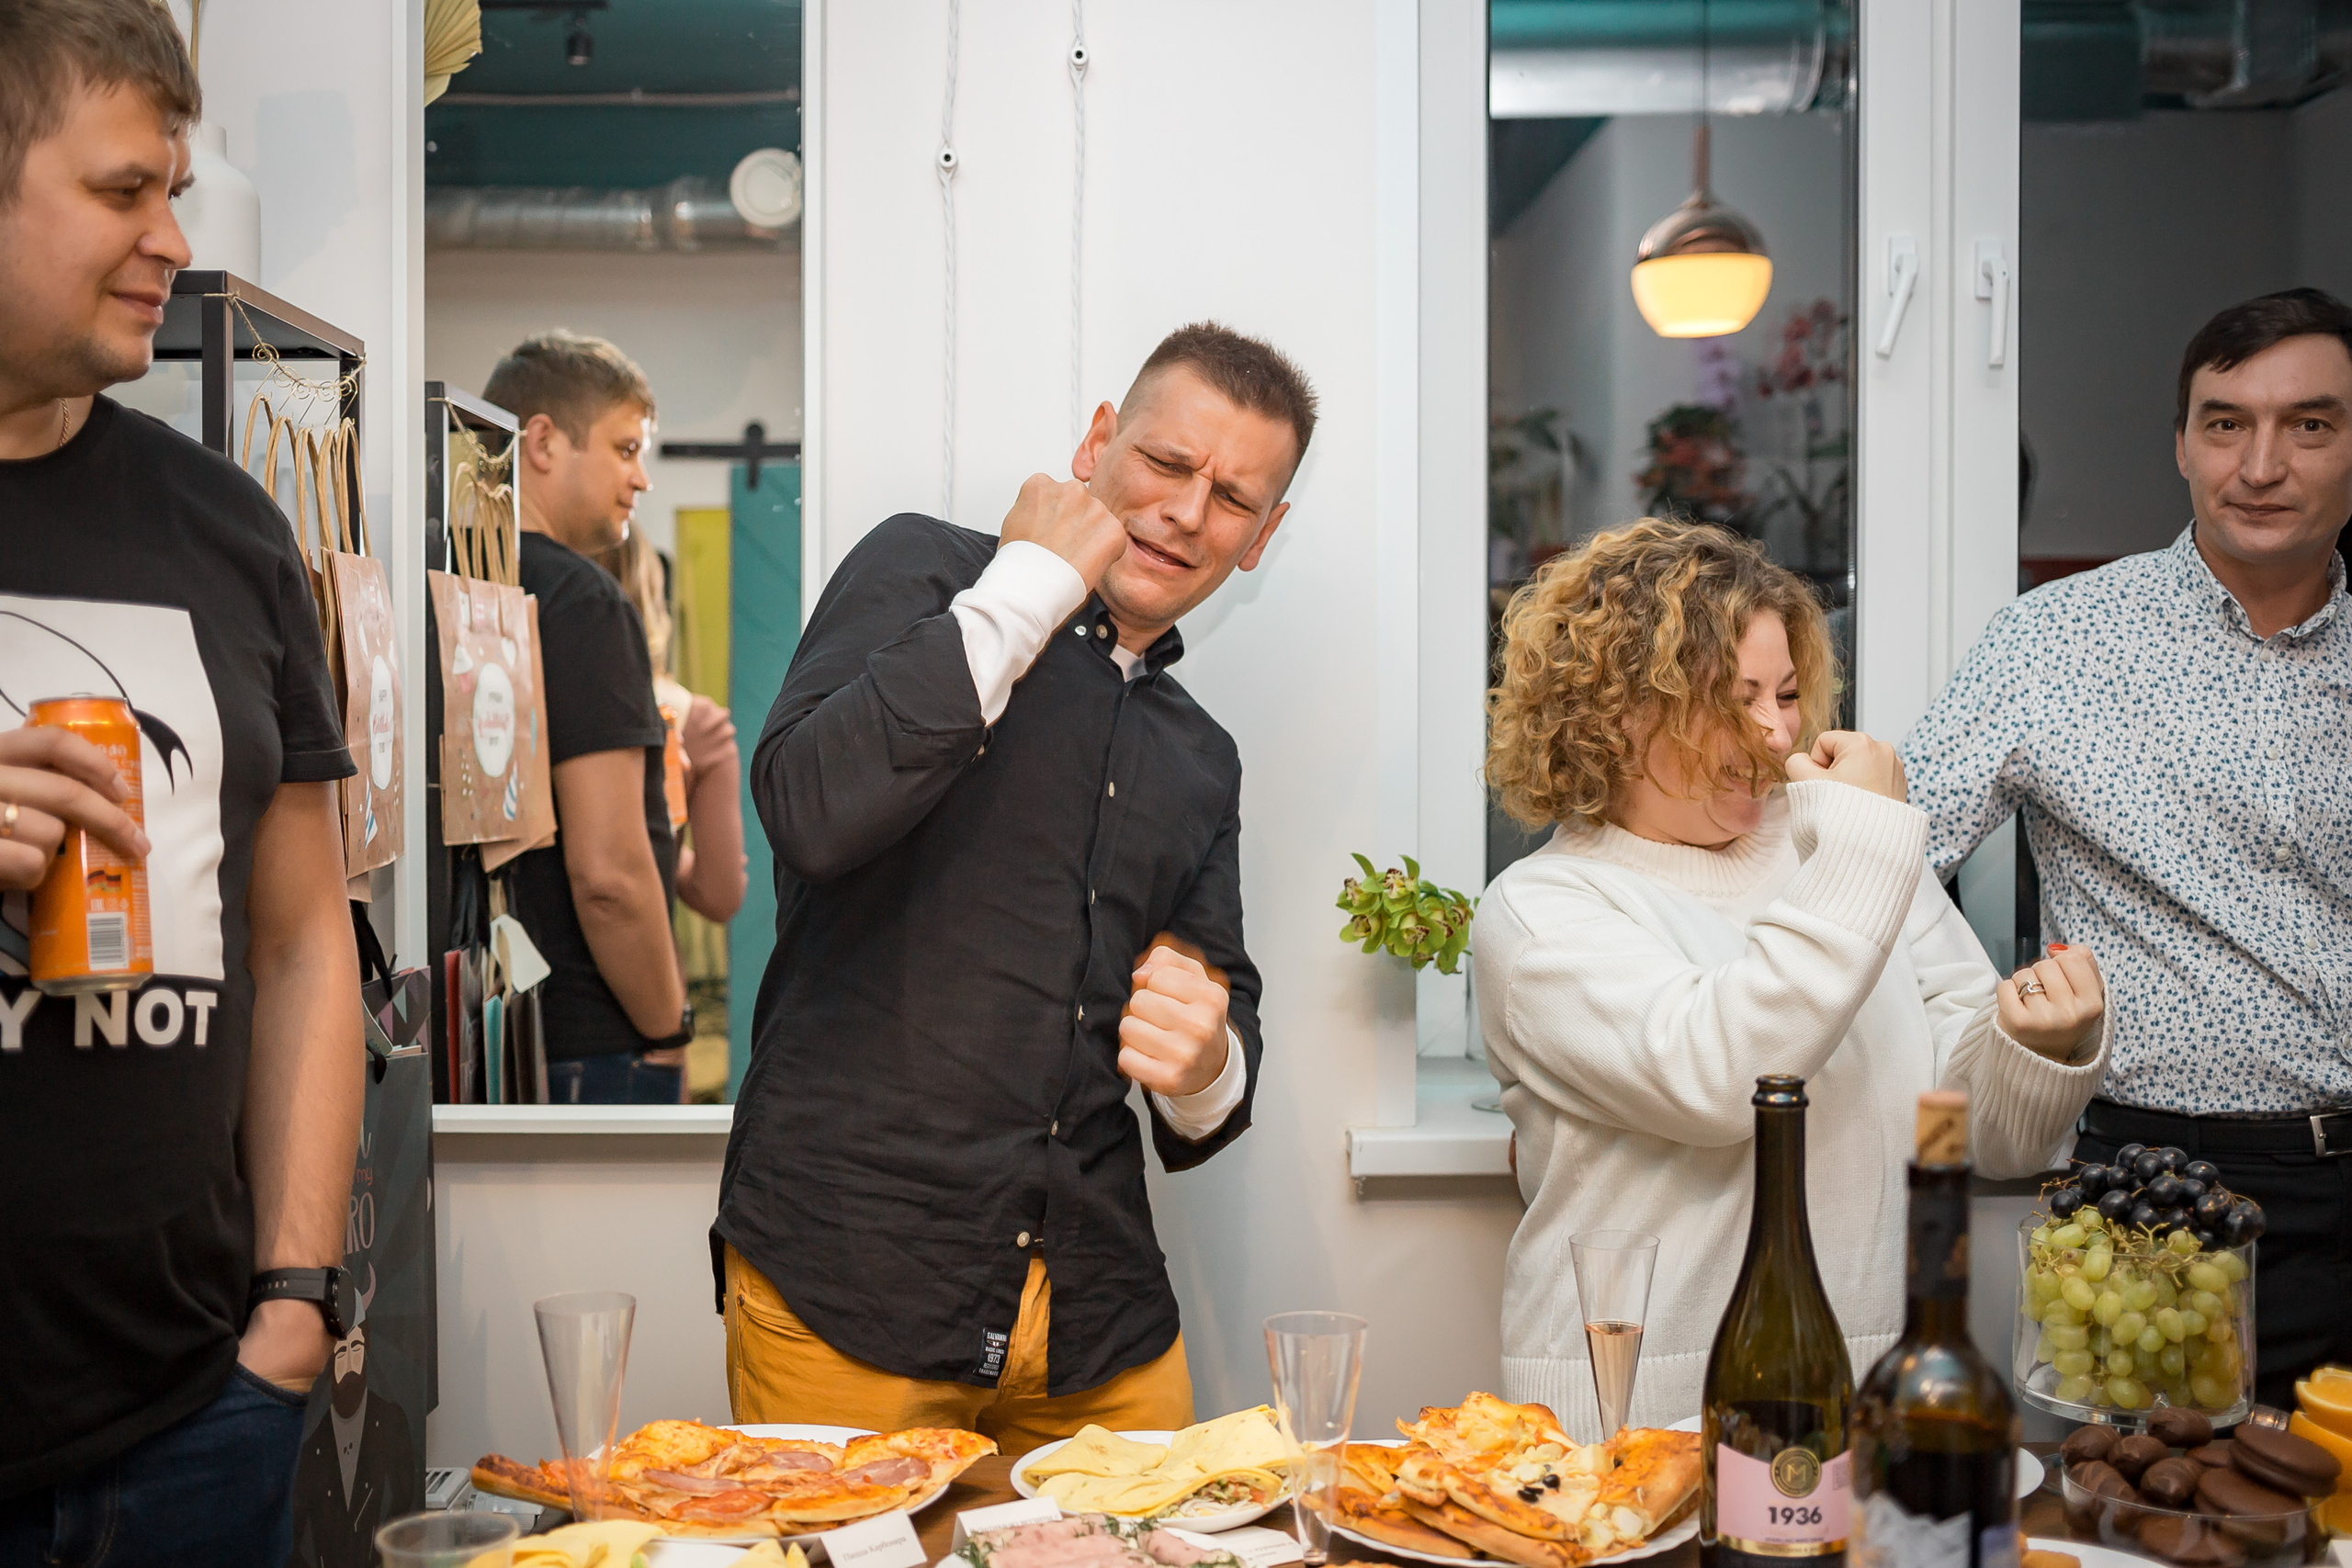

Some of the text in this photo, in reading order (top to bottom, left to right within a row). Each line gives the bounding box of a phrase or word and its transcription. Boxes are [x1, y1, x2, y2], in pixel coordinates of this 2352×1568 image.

[74, 987, 218, 1048] NOT
[345, 1191, 375, 1256] RO
[1768, 1506, 1823, 1525] 1936
